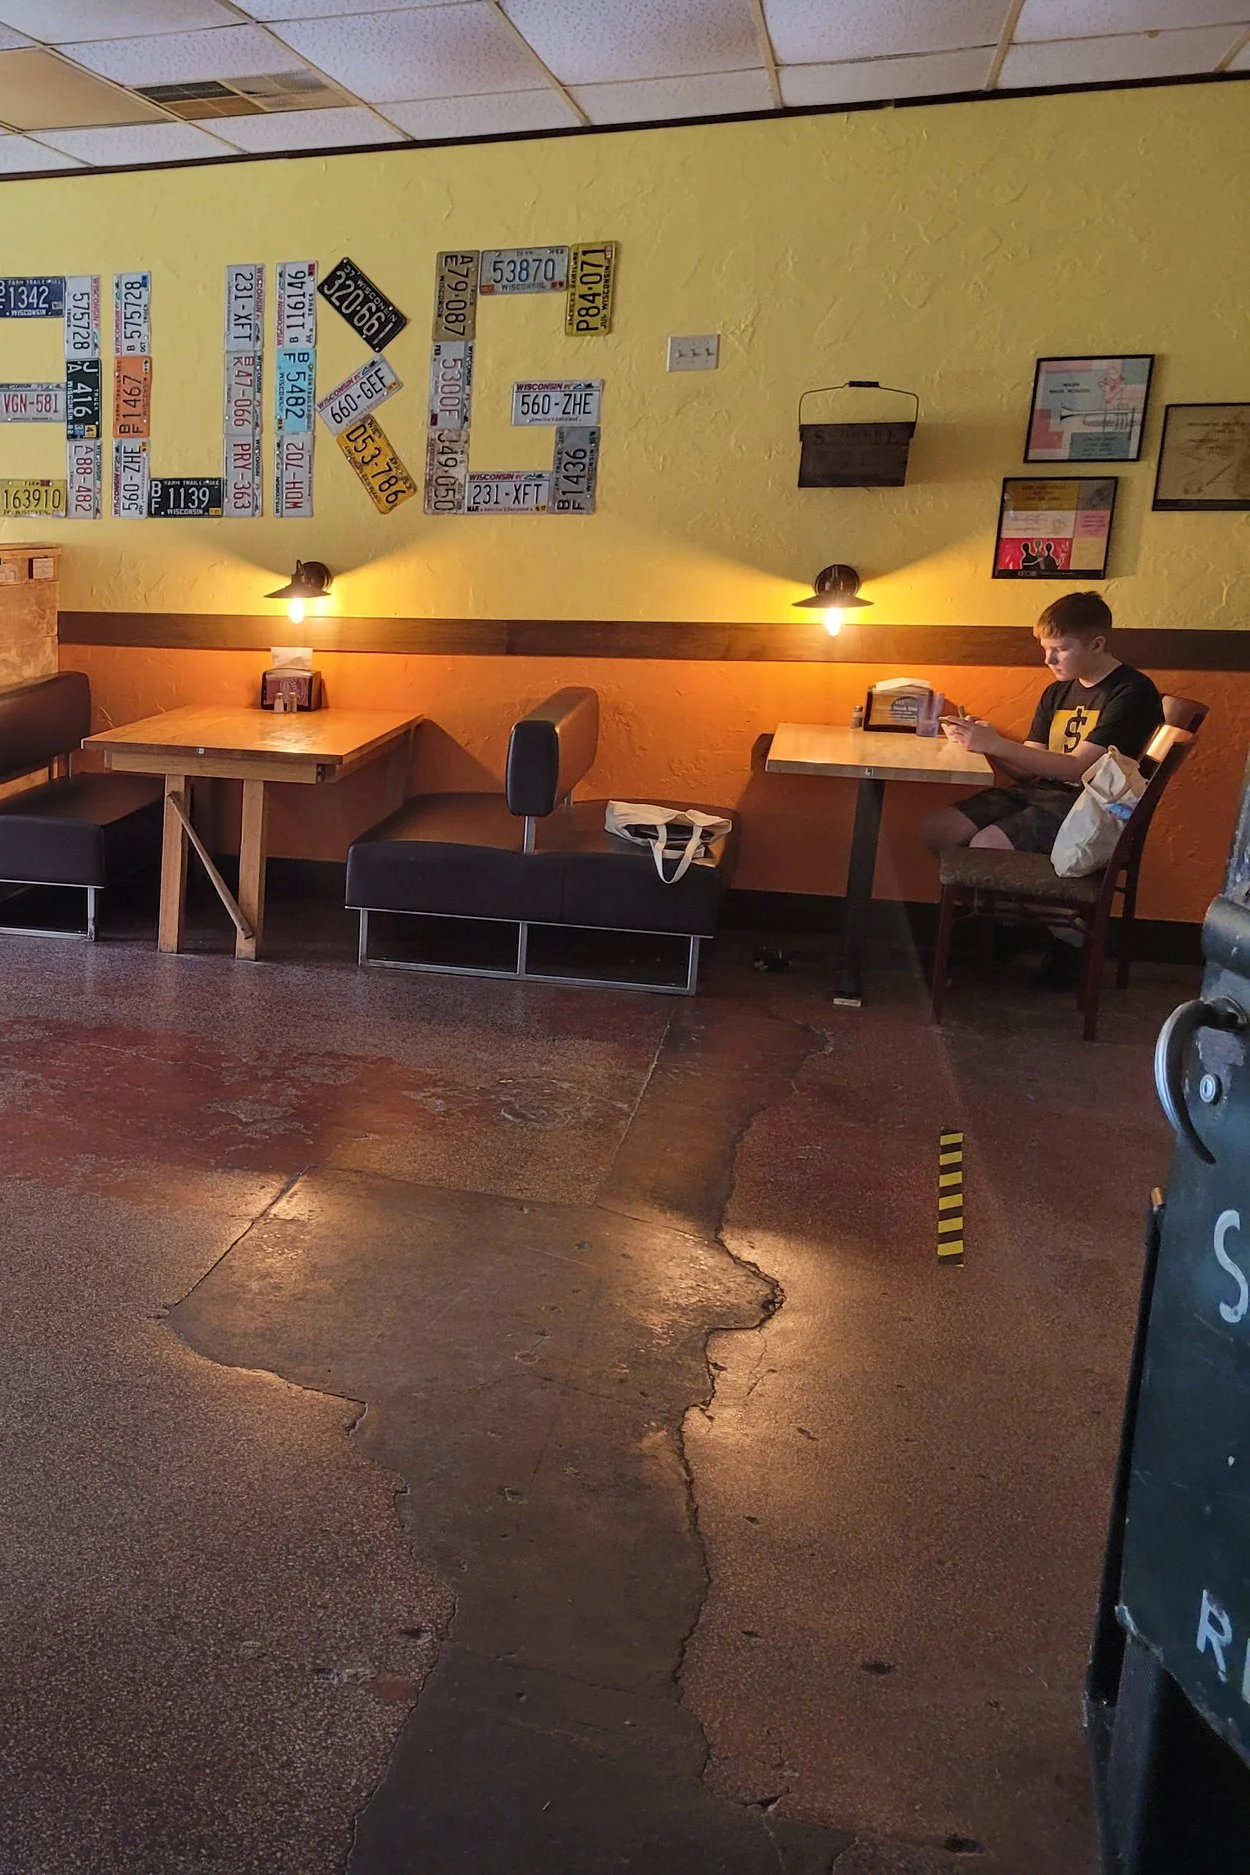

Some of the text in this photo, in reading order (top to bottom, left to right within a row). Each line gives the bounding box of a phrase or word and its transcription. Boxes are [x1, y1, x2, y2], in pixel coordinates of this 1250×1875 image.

[492, 257, 556, 284] 53870
[501, 282, 545, 291] WISCONSIN
[601, 264, 611, 311] WISCONSIN
[9, 285, 49, 309] 1342
[11, 308, 47, 316] WISCONSIN
[124, 280, 142, 340] 575728
[233, 272, 253, 342] 231-XFT
[286, 270, 306, 329] 116146
[356, 278, 397, 323] WISCONSIN
[437, 275, 445, 318] WISCONSIN
[72, 292, 90, 351] 575728
[2, 393, 59, 413] VGN-581
[72, 381, 93, 418] 416
[122, 374, 142, 419] 1467
[233, 369, 253, 428] 47-066
[285, 370, 306, 420] 5482
[330, 368, 387, 425] 660-GEF
[439, 358, 463, 421] 5300F
[516, 383, 563, 391] WISCONSIN
[521, 393, 594, 416] 560-ZHE
[75, 457, 93, 513] 88-482
[123, 444, 141, 511] 560-ZHE
[233, 442, 252, 510] PRY-363
[285, 442, 304, 510] WDH-702
[468, 473, 514, 481] WISCONSIN
[561, 447, 588, 497] 1436
[586, 448, 595, 492] WISCONSIN
[4, 488, 61, 509] 163910
[168, 487, 210, 509] 1139
[473, 483, 542, 505] 231-XFT
